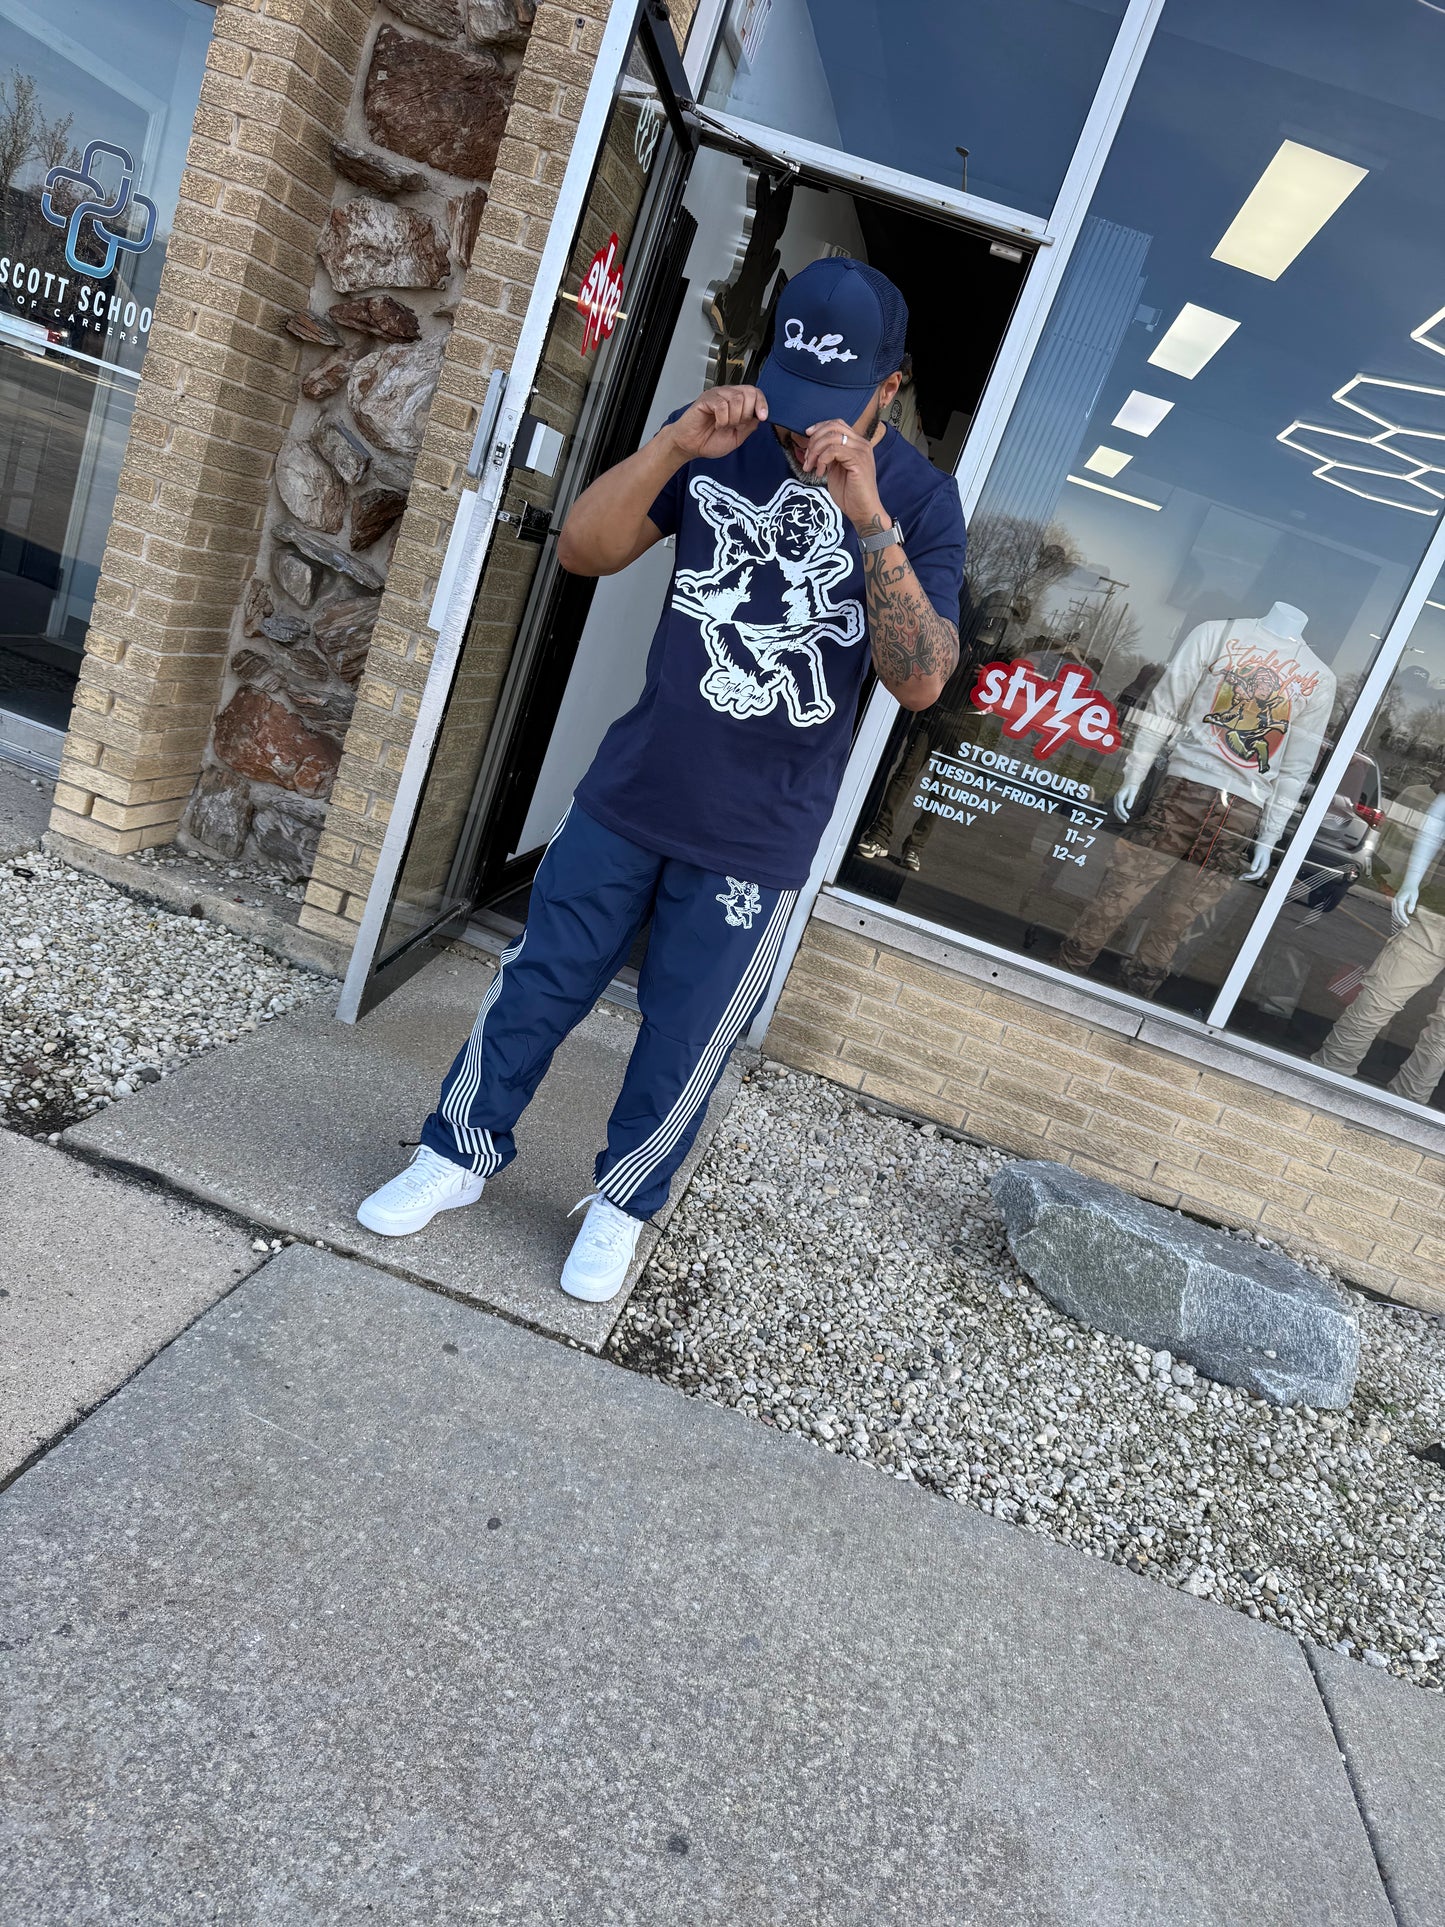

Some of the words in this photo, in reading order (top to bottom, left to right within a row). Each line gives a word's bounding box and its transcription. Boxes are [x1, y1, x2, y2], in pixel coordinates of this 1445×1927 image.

[0, 257, 69, 303] SCOTT
[78, 286, 152, 333] SCHOO
[17, 295, 38, 308] OF
[53, 308, 138, 344] CAREERS
[957, 741, 1021, 776] STORE
[1021, 763, 1091, 800] HOURS
[912, 794, 977, 826] SUNDAY
[1051, 844, 1088, 867] 12-4
[919, 776, 1002, 815] SATURDAY
[1064, 828, 1096, 849] 11-7
[1069, 808, 1104, 831] 12-7
